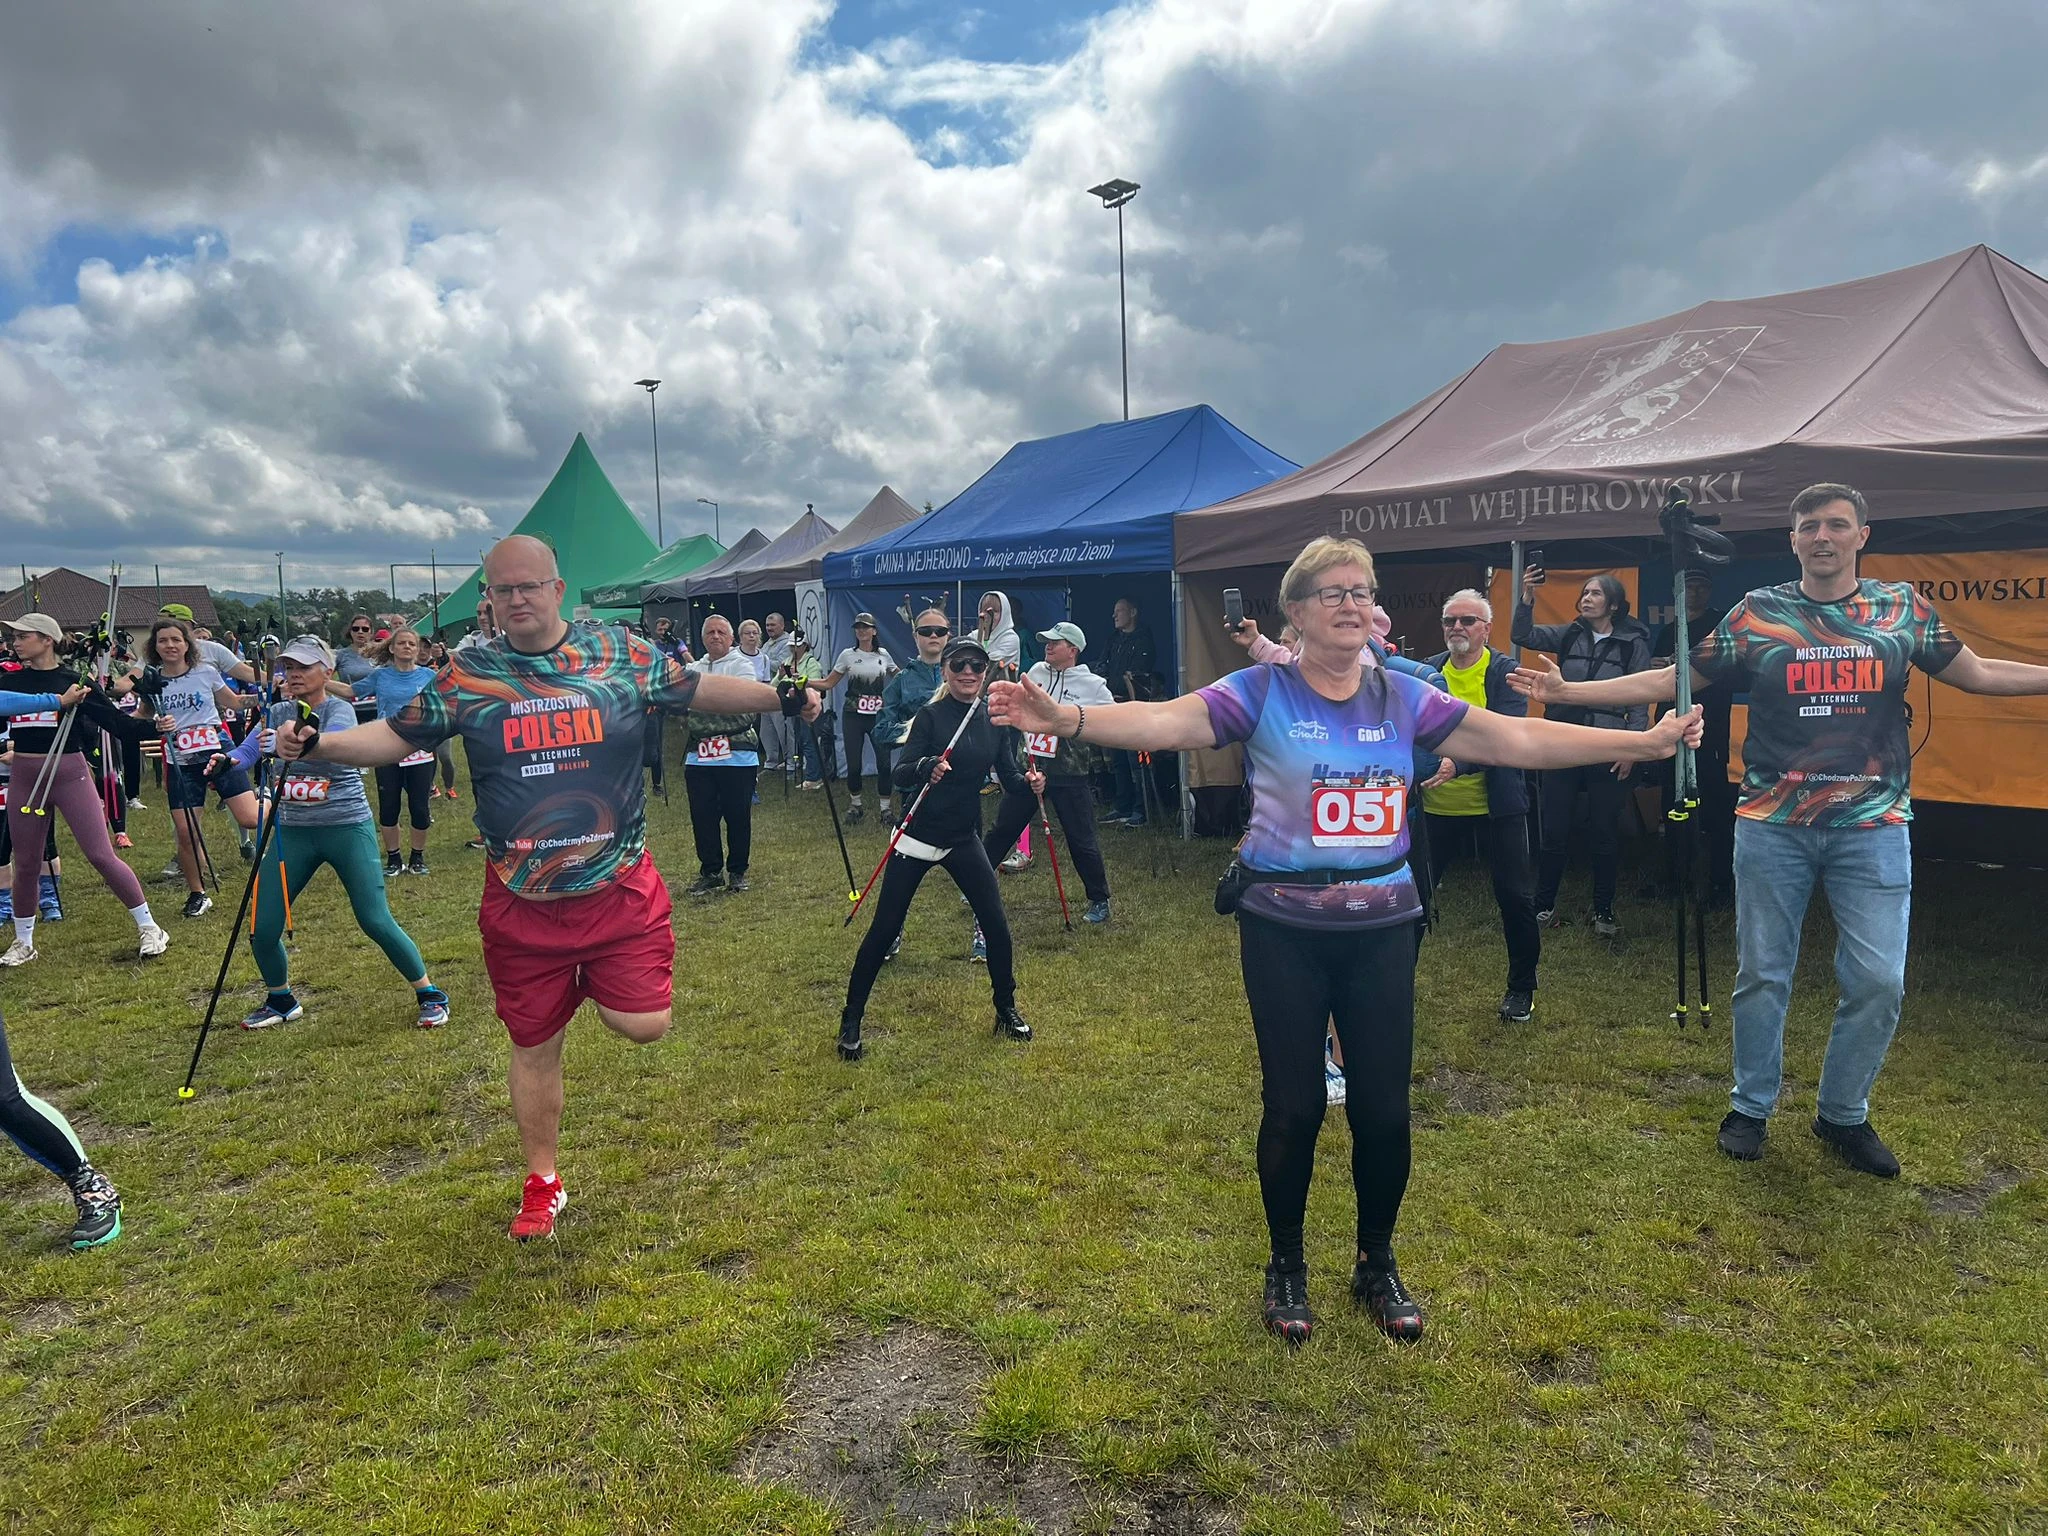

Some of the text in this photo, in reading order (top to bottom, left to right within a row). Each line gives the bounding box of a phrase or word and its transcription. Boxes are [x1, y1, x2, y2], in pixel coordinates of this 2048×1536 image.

[1339, 470, 1744, 535] POWIAT WEJHEROWSKI
[874, 552, 904, 575] GMINA
[906, 546, 971, 572] WEJHEROWO
[983, 547, 1014, 571] Twoje
[1014, 544, 1059, 570] miejsce
[1058, 546, 1078, 563] na
[1077, 538, 1115, 562] Ziemi
[1911, 576, 2048, 601] ROWSKI
[1796, 645, 1874, 660] MISTRZOSTWA
[1786, 659, 1884, 695] POLSKI
[163, 692, 186, 703] RON
[510, 694, 590, 716] MISTRZOSTWA
[858, 698, 883, 711] 082
[1820, 694, 1859, 704] TECHNICE
[1802, 705, 1867, 715] NORDIC WALKING
[503, 708, 604, 754] POLSKI
[1357, 726, 1386, 742] GABI
[178, 732, 219, 749] 048
[698, 739, 731, 757] 042
[1027, 732, 1058, 753] 041
[530, 747, 581, 762] W TECHNICE
[524, 759, 590, 775] NORDIC WALKING
[1316, 790, 1403, 833] 051
